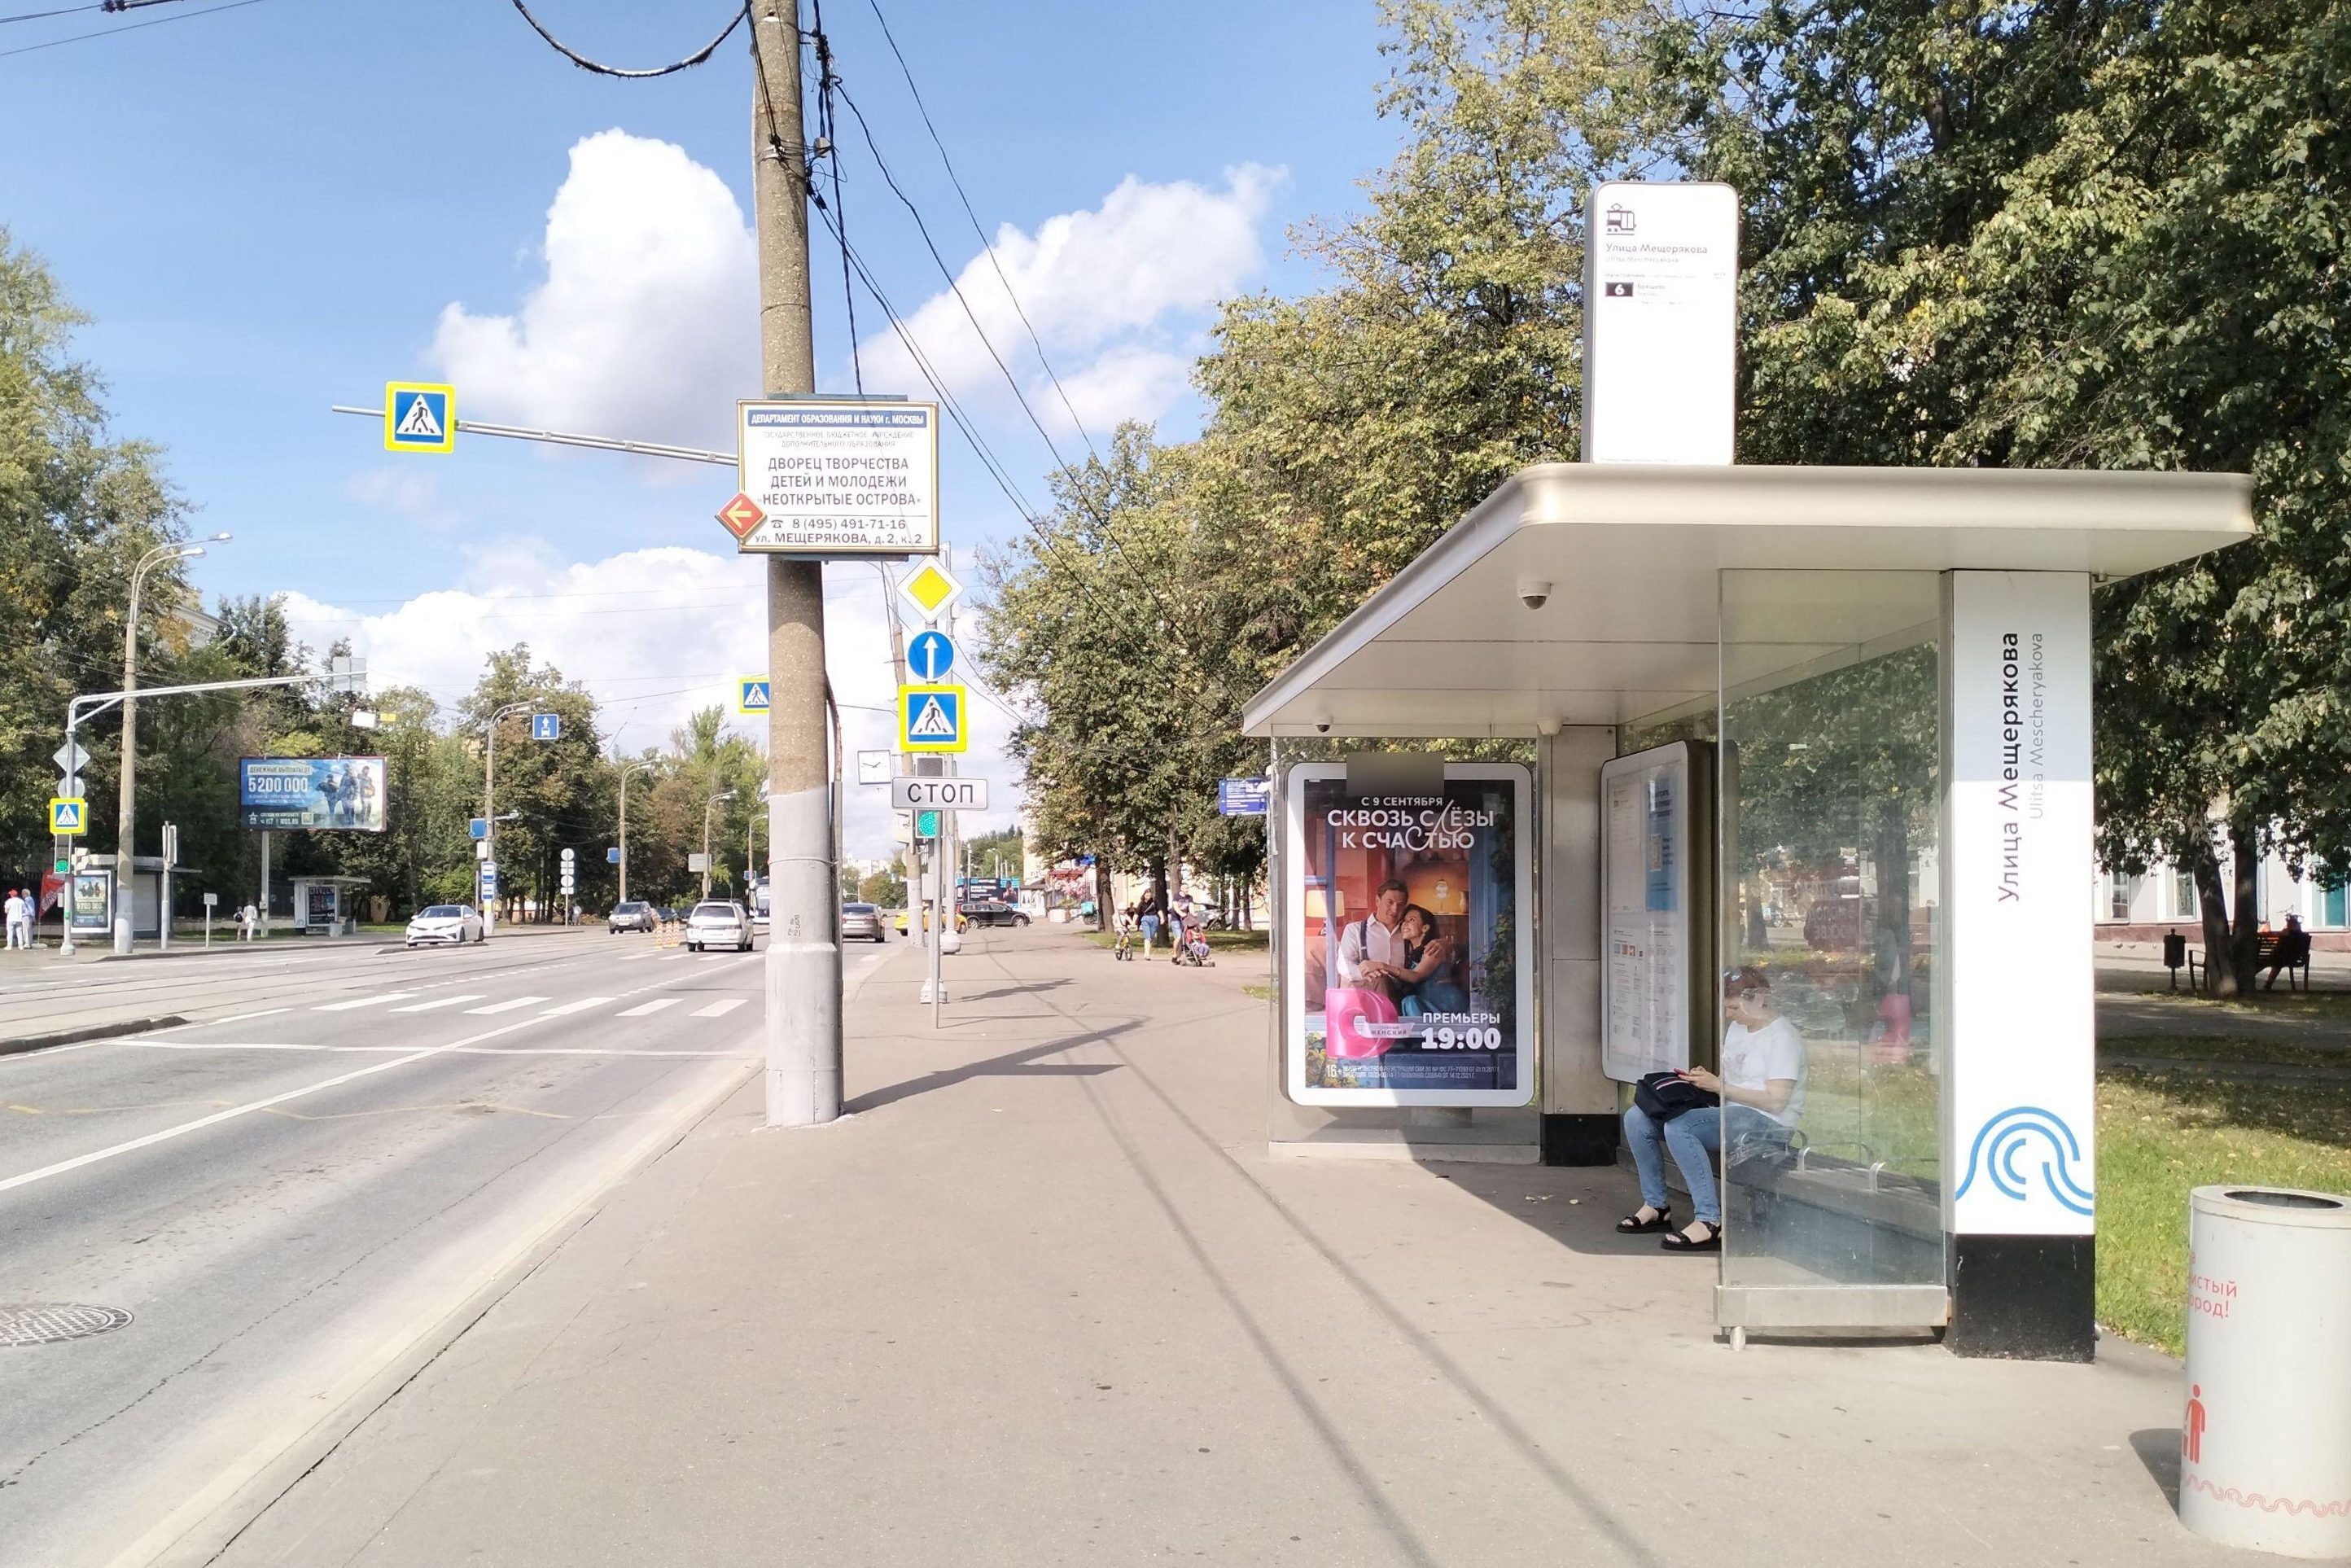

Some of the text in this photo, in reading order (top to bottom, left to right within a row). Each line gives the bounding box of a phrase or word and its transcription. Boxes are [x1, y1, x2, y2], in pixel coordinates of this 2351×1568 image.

[1606, 243, 1708, 254] Улица Мещерякова
[1614, 283, 1625, 296] 6
[751, 414, 924, 425] ДЕПАРТАМЕНТ ОБРАЗОВАНИЯ И НАУКИ г. МОСКВЫ
[768, 457, 909, 471] ДВОРЕЦ ТВОРЧЕСТВА
[770, 473, 907, 489] ДЕТЕЙ И МОЛОДЕЖИ
[792, 519, 906, 530] 8 (495) 491-71-16
[755, 535, 770, 544] ул.
[775, 532, 871, 545] МЕЩЕРЯКОВА,
[914, 534, 922, 545] 2
[2029, 633, 2047, 820] Ulitsa Mescheryakova
[1999, 632, 2023, 902] Улица Мещерякова
[248, 777, 309, 793] 5 200 000
[908, 783, 974, 804] СТОП
[1361, 796, 1443, 806] С 9 СЕНТЯБРЯ
[1327, 799, 1494, 834] СКВОЗЬ СЛЁЗЫ
[1342, 826, 1475, 852] К СЧАСТЬЮ
[1422, 1012, 1500, 1024] ПРЕМЬЕРЫ
[1421, 1027, 1501, 1049] 19:00
[1325, 1064, 1343, 1079] 16+
[2189, 1275, 2238, 1299] истый
[2189, 1294, 2229, 1320] ород!
